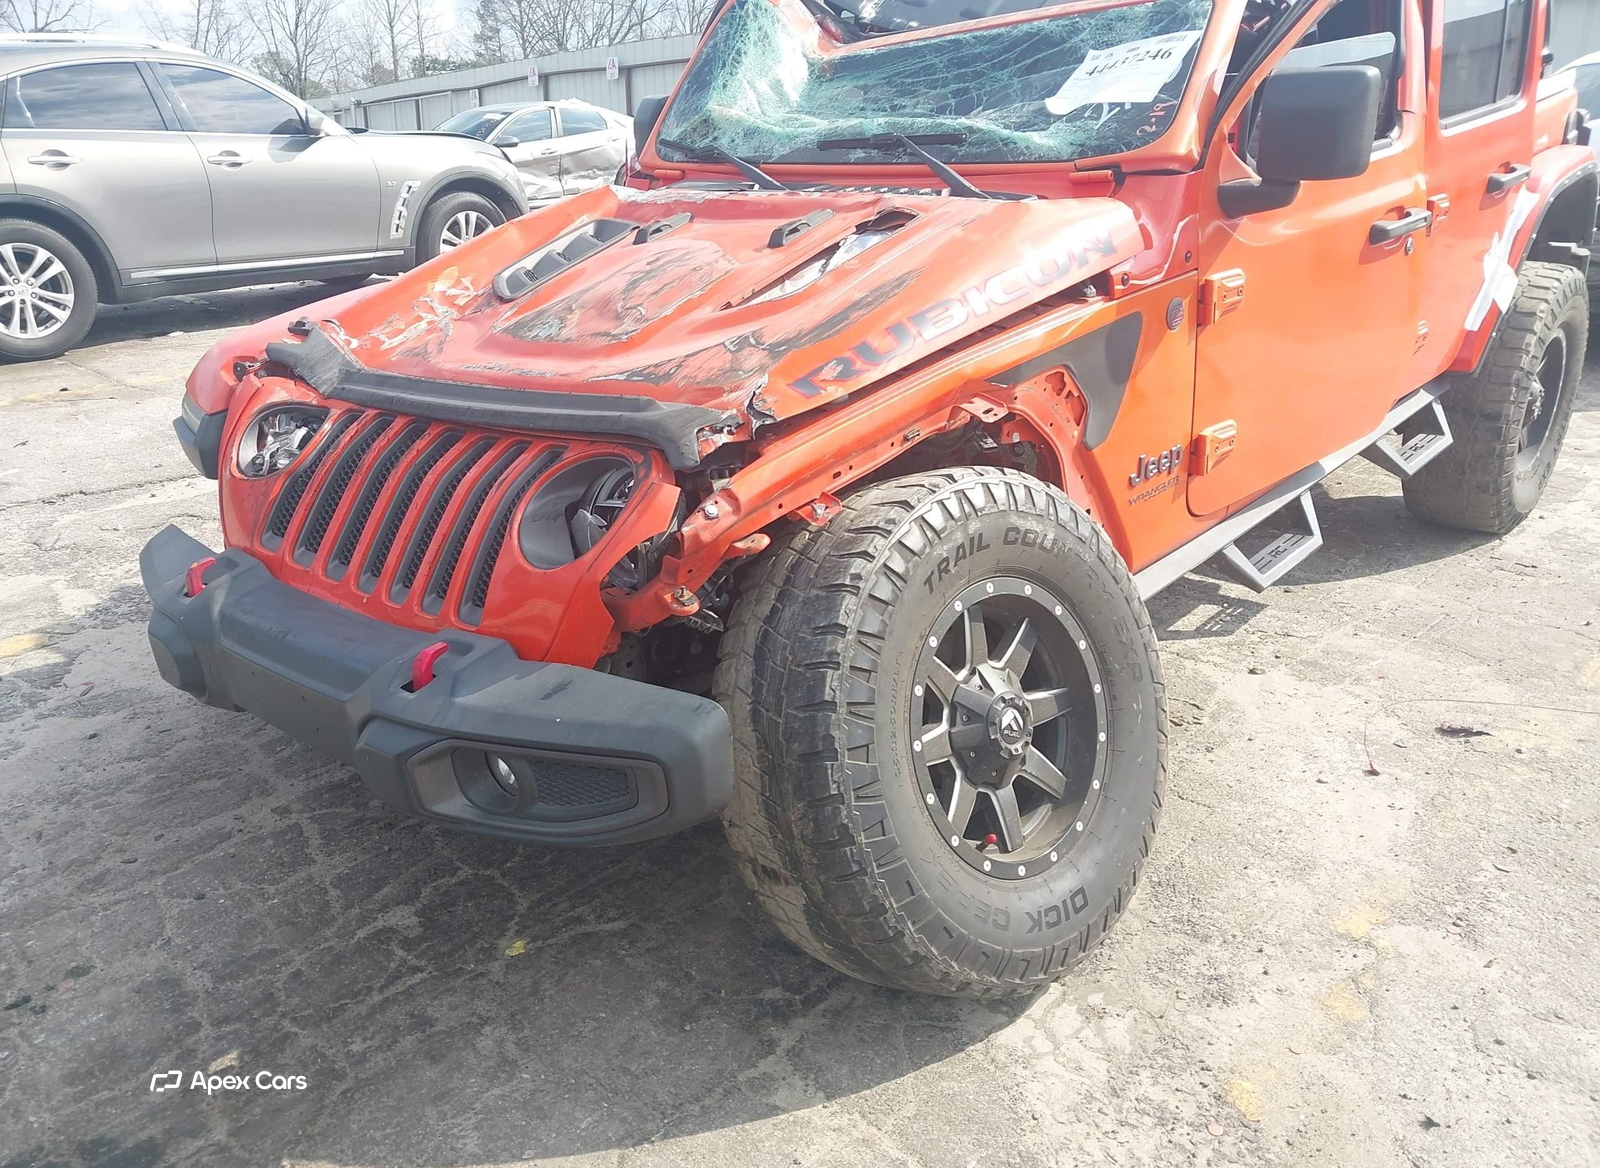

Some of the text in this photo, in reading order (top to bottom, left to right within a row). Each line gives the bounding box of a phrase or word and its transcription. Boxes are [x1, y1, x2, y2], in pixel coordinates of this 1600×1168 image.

[1085, 46, 1177, 77] 44437246
[787, 230, 1118, 399] RUBICON
[1128, 444, 1183, 488] Jeep
[1128, 475, 1180, 506] WRANGLER
[923, 532, 991, 596] TRAIL
[1003, 728, 1021, 738] FUEL
[1025, 885, 1089, 934] DICK
